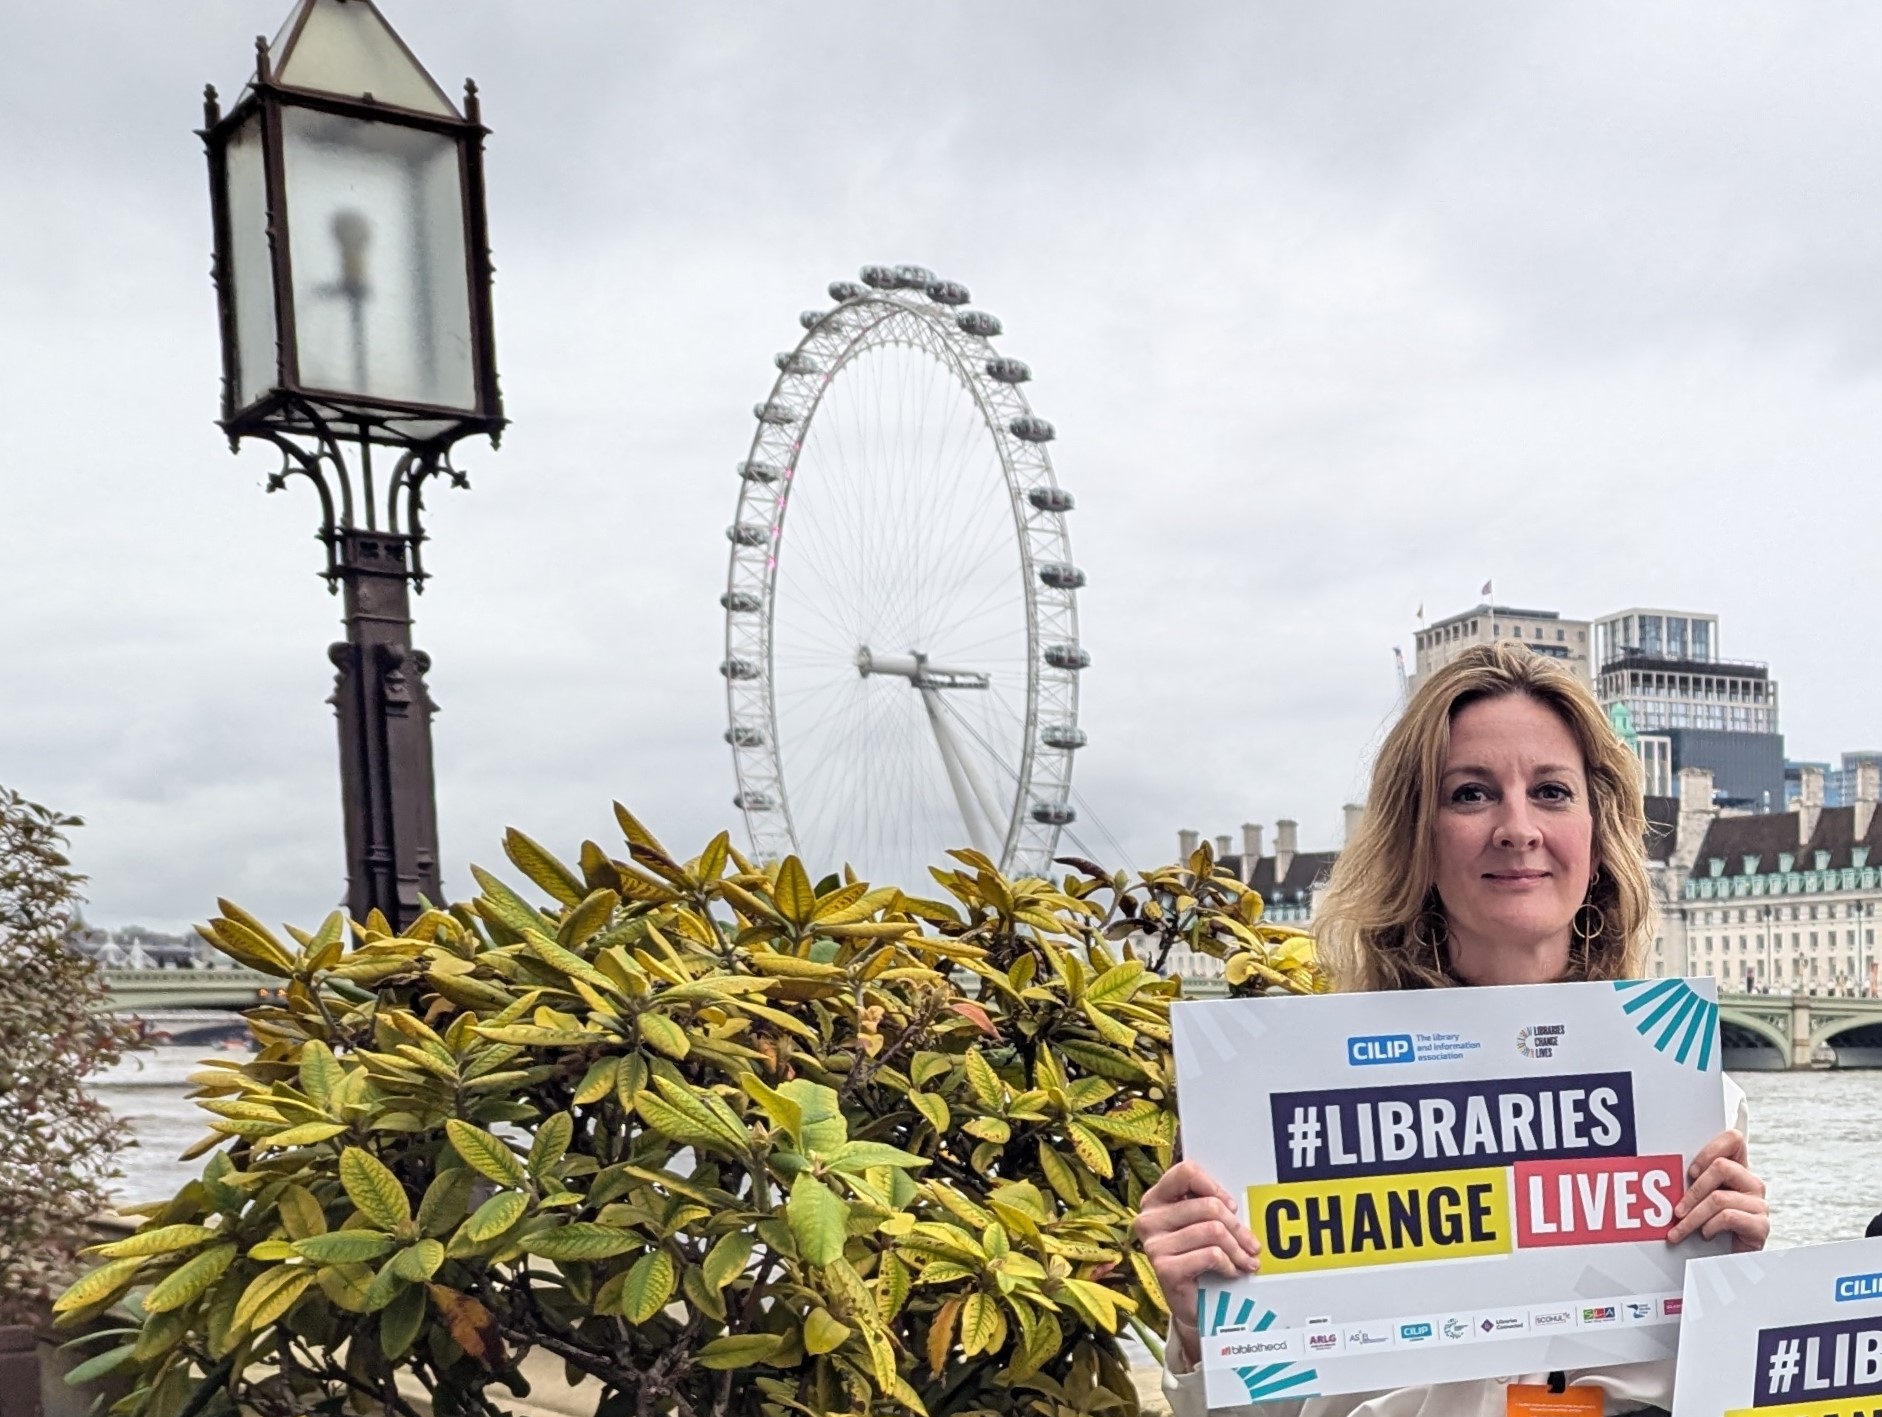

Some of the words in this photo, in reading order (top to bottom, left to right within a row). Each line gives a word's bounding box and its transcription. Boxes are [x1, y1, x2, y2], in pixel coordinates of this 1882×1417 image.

[1533, 1025, 1565, 1036] LIBRARIES
[1416, 1034, 1431, 1042] The
[1433, 1033, 1460, 1043] library
[1534, 1037, 1558, 1047] CHANGE
[1353, 1040, 1409, 1061] CILIP
[1417, 1043, 1432, 1052] and
[1433, 1041, 1481, 1051] information
[1418, 1052, 1463, 1061] association
[1536, 1048, 1553, 1058] LIVES
[1287, 1087, 1622, 1168] #LIBRARIES
[1265, 1183, 1497, 1260] CHANGE
[1528, 1169, 1674, 1234] LIVES
[1403, 1326, 1429, 1336] CILIP
[1309, 1334, 1337, 1344] ARLG
[1232, 1341, 1287, 1355] bibliotheca
